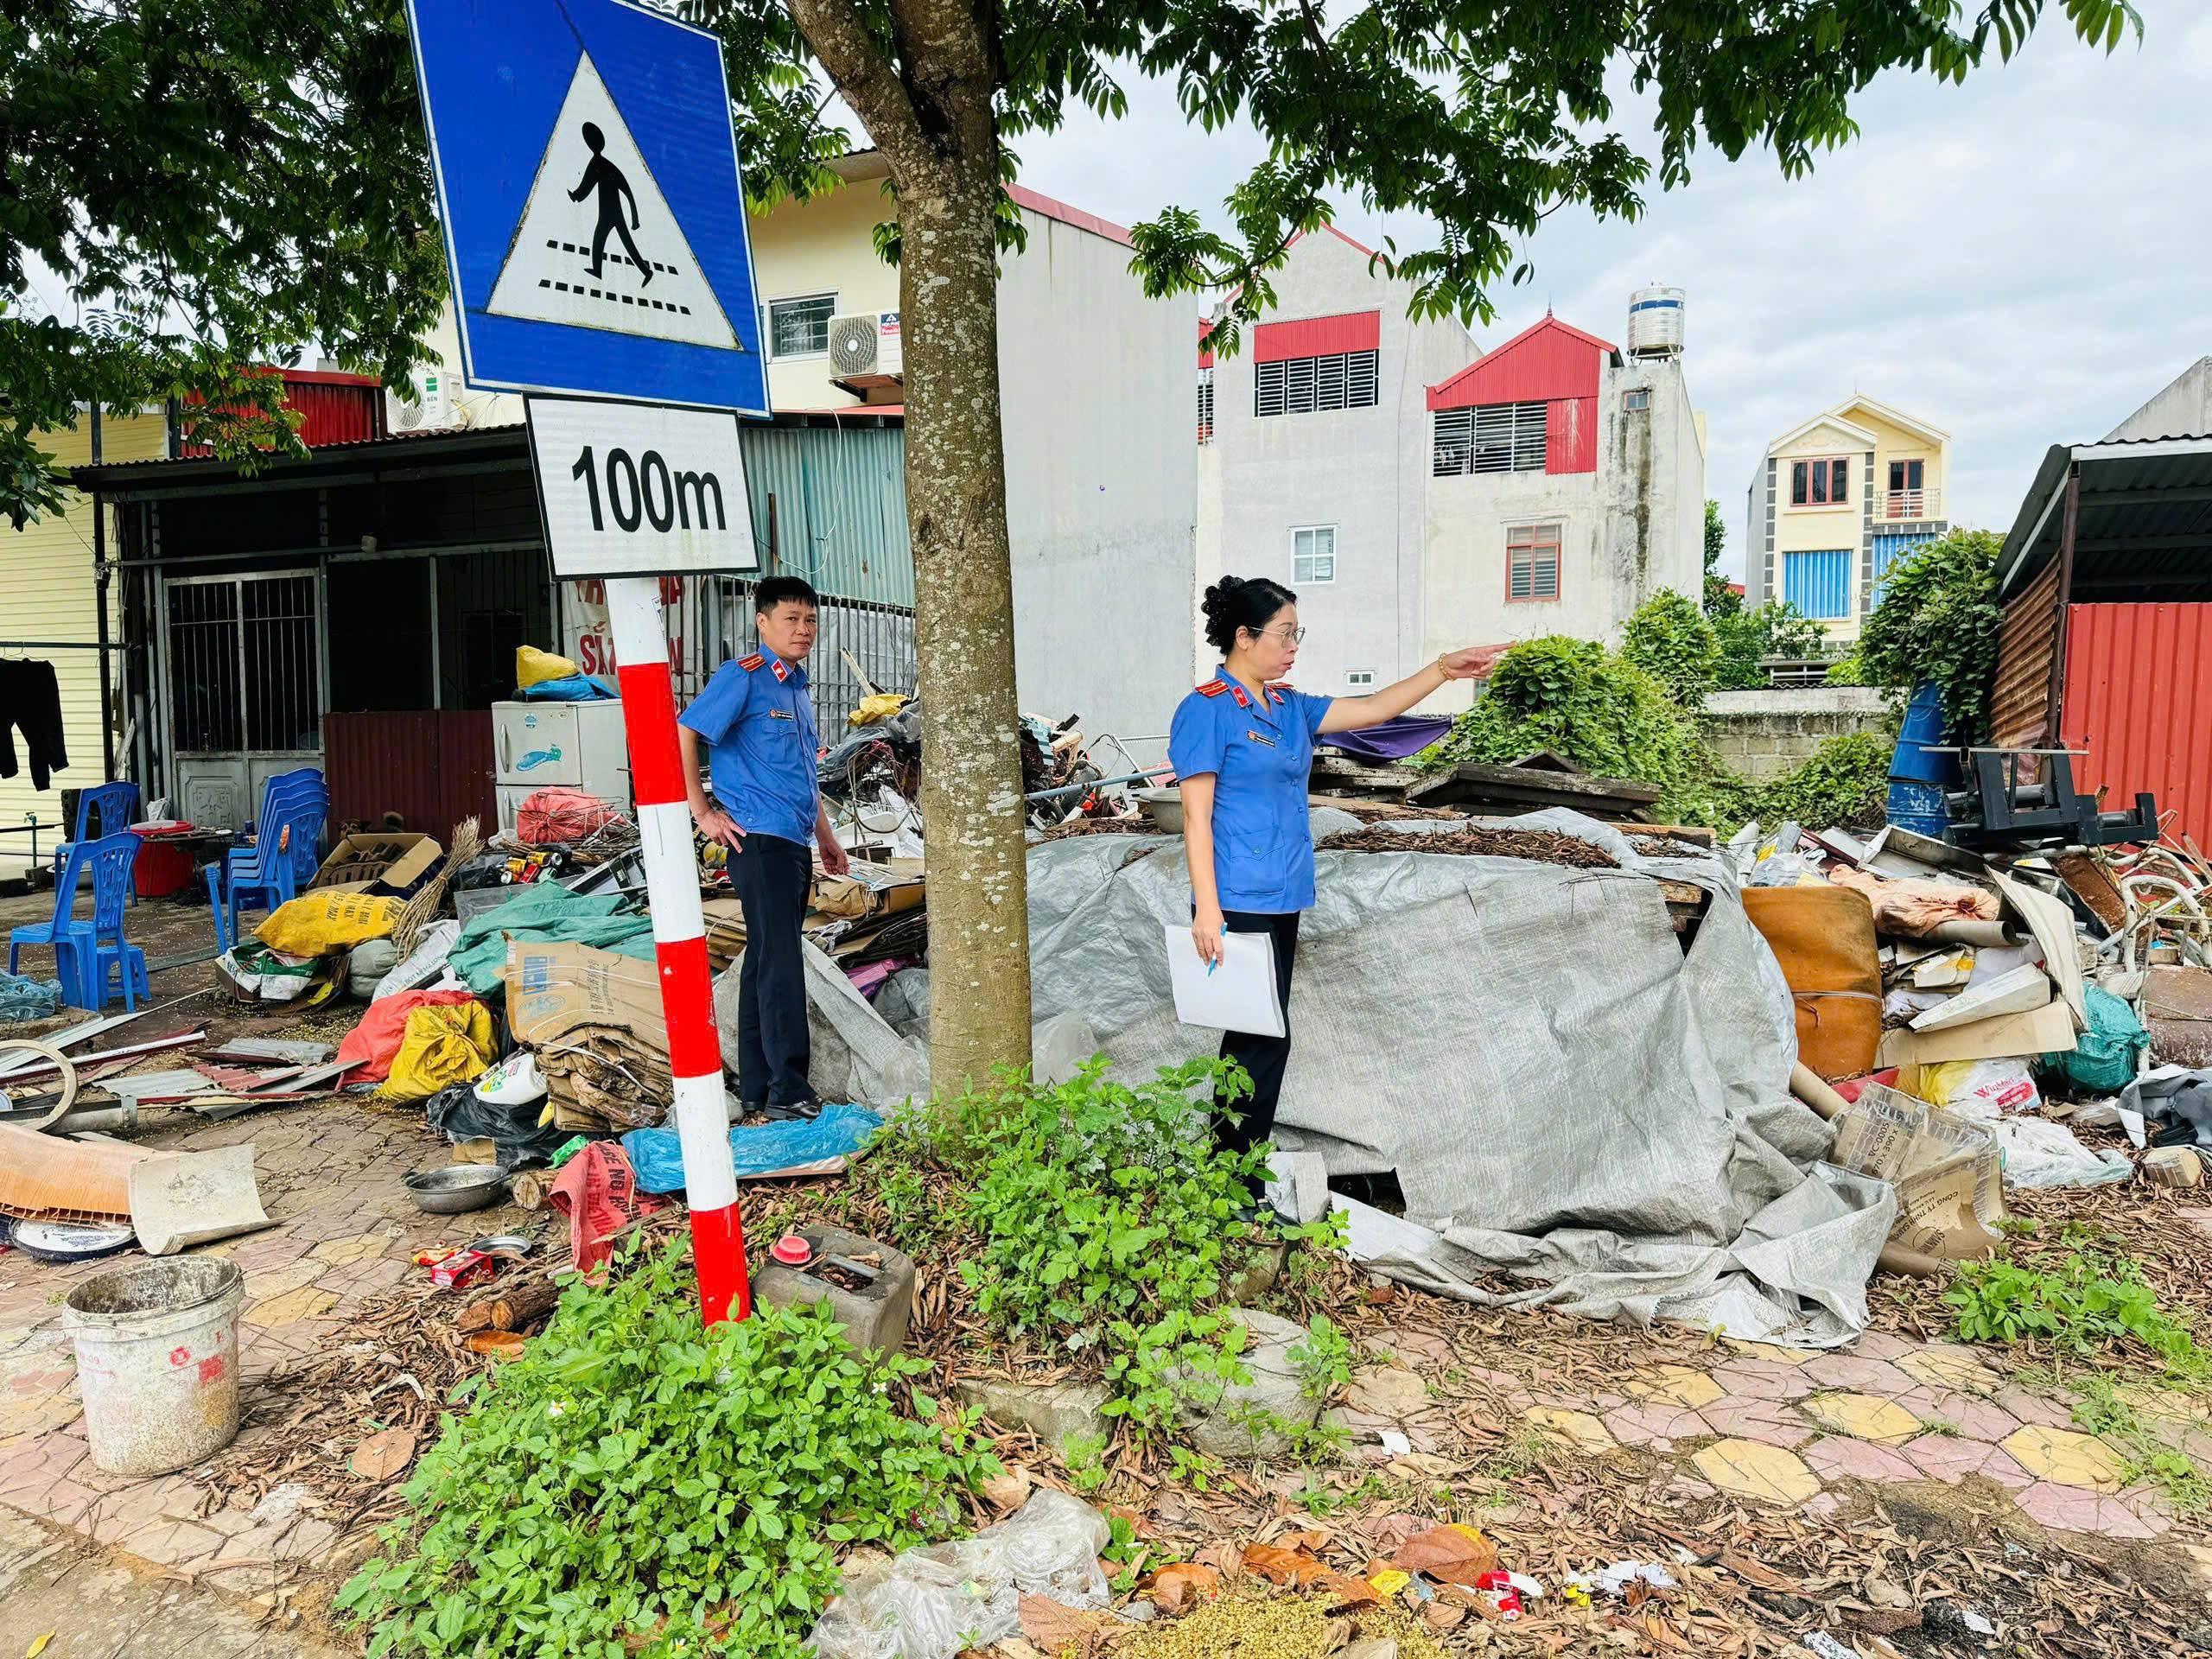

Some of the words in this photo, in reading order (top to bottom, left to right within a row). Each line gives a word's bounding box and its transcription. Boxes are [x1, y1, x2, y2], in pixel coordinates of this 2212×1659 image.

[572, 445, 727, 533] 100m
[1868, 1122, 1890, 1157] VC-0005
[1872, 1159, 1884, 1175] 670
[1884, 1135, 1896, 1153] 390
[608, 1168, 626, 1191] NO
